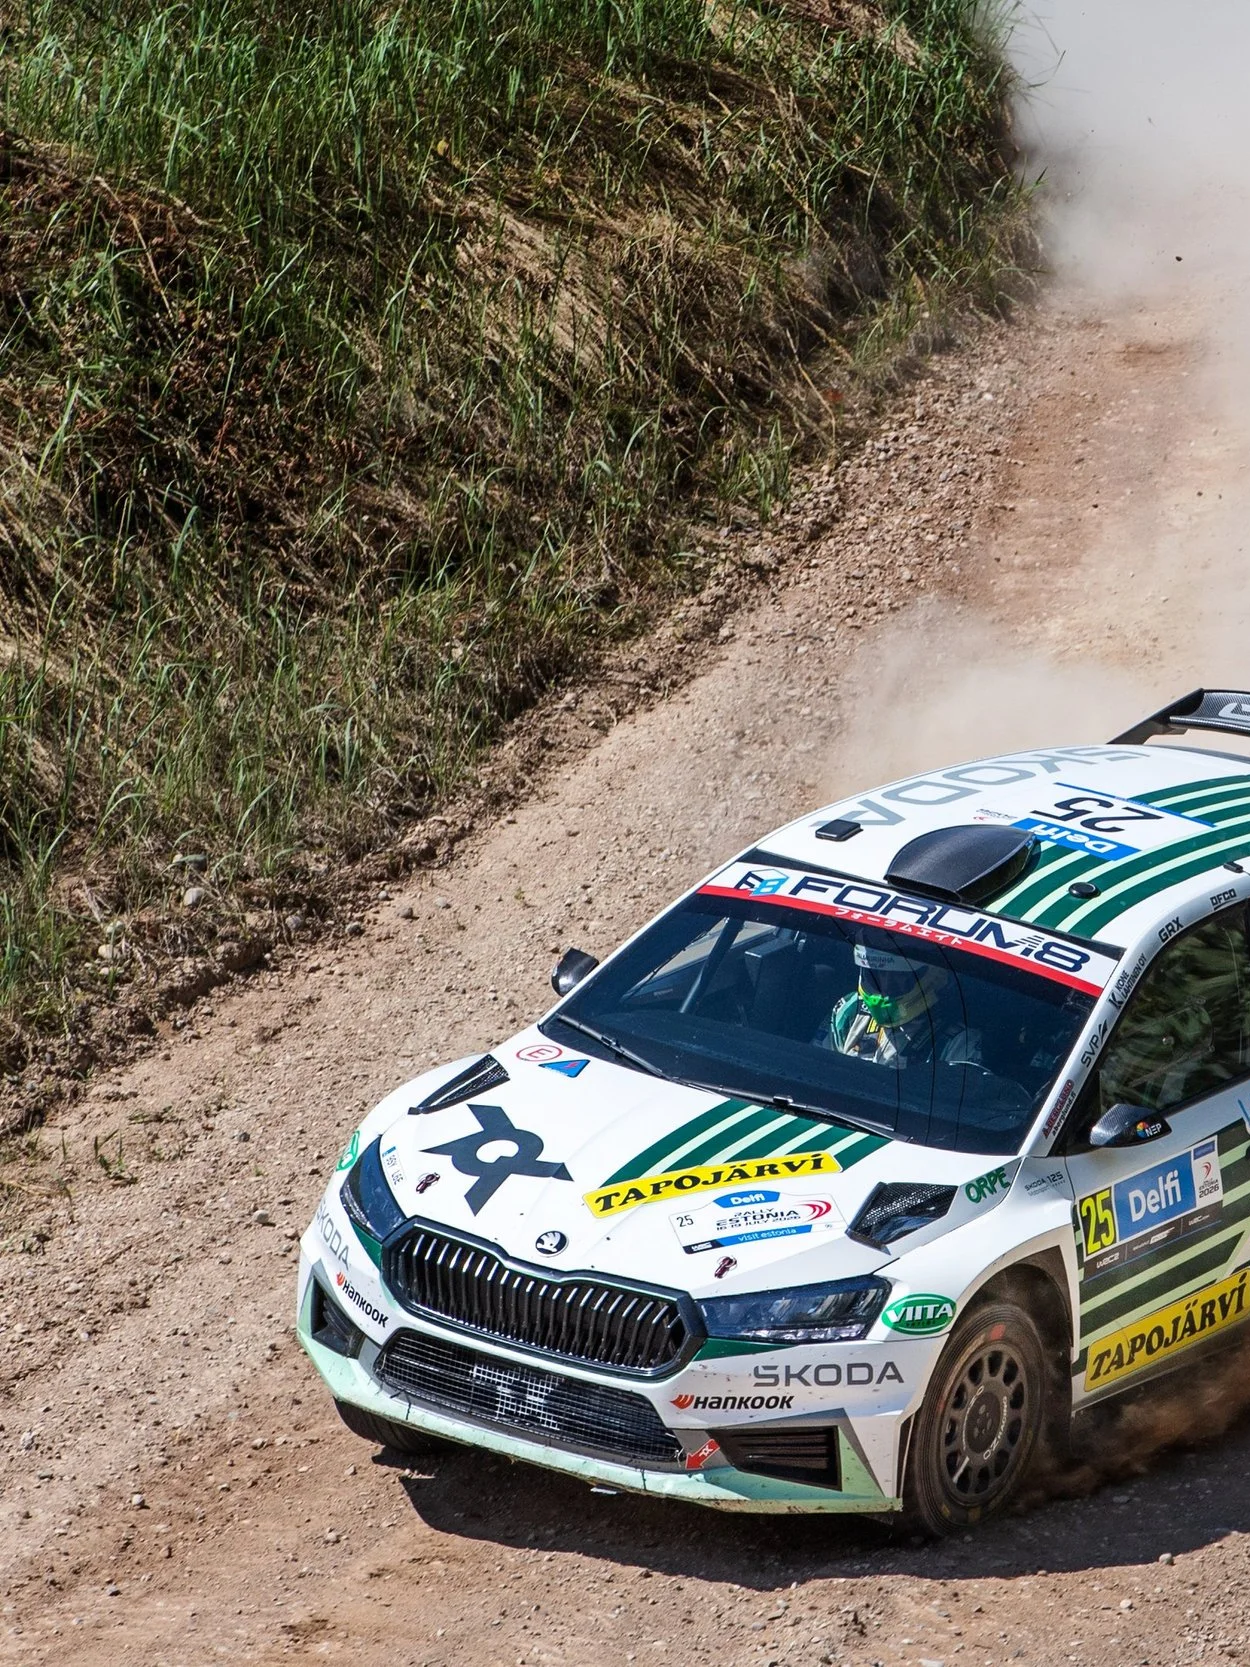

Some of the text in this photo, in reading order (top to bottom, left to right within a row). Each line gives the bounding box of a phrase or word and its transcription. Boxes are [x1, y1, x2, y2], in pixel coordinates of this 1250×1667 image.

[809, 747, 1151, 827] SKODA
[1030, 797, 1164, 832] 25
[1028, 823, 1118, 854] Delfi
[788, 875, 1091, 973] FORUM8
[834, 908, 963, 946] フォーラムエイト
[1158, 916, 1185, 944] GRX
[1116, 969, 1130, 992] KONE
[1121, 962, 1142, 1000] LAHTINEN
[1081, 1034, 1101, 1068] SVP
[965, 1167, 1011, 1204] ORPE
[1047, 1171, 1064, 1185] 125
[1199, 1185, 1220, 1199] 2026
[730, 1193, 766, 1206] Delfi
[1128, 1169, 1182, 1223] Delfi
[676, 1215, 695, 1228] 25
[715, 1210, 800, 1227] ESTONIA
[1081, 1189, 1116, 1254] 25
[738, 1228, 797, 1242] visit estonia
[885, 1302, 954, 1324] VIITA
[753, 1361, 904, 1387] SKODA
